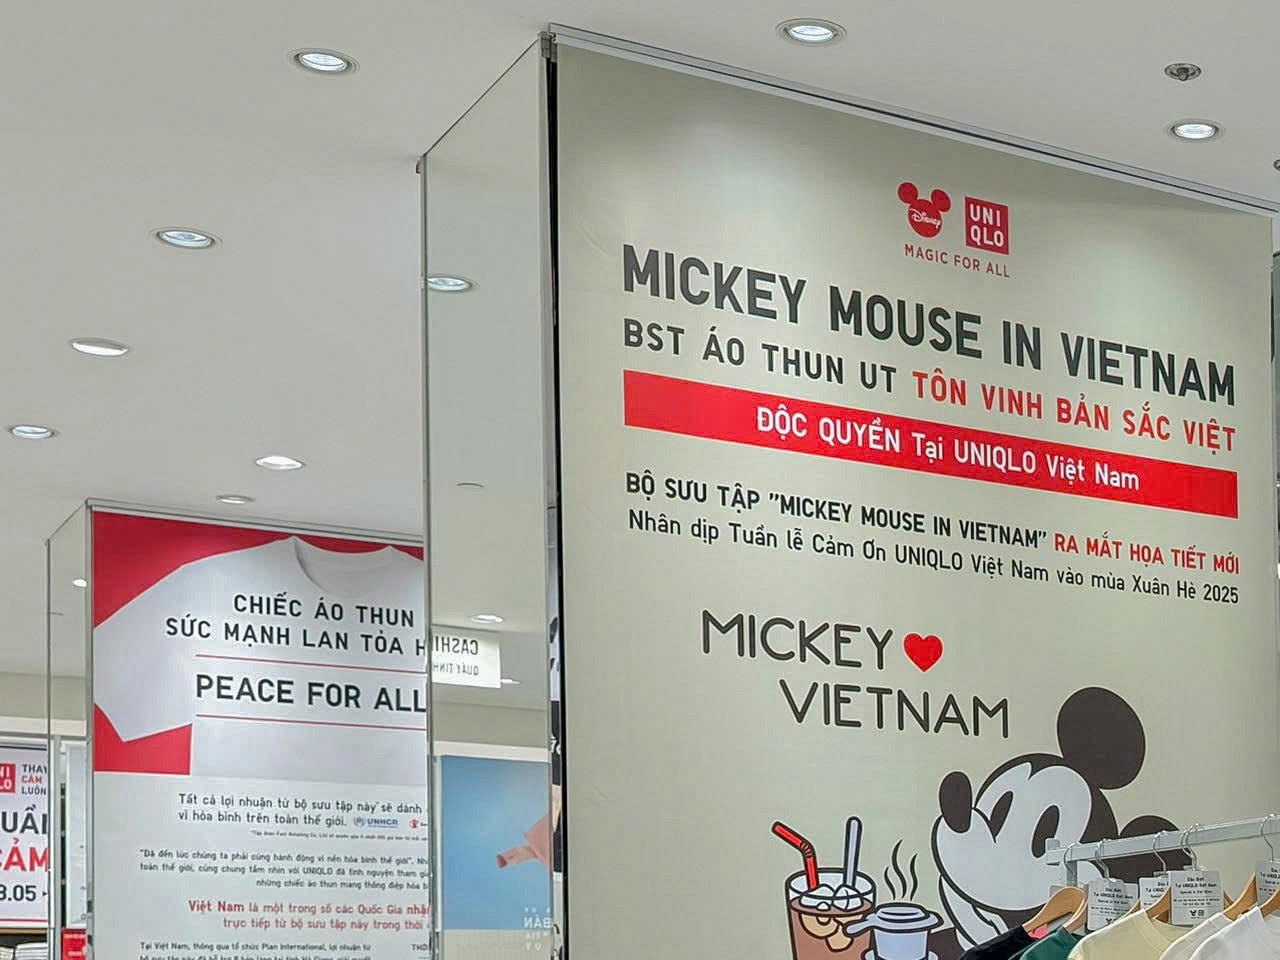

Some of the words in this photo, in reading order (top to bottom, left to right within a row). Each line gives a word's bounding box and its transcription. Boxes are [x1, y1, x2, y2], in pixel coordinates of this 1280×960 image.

[969, 203, 1001, 227] UNI
[970, 225, 1004, 247] QLO
[905, 243, 949, 265] MAGIC
[954, 254, 980, 272] FOR
[986, 261, 1010, 278] ALL
[623, 243, 807, 324] MICKEY
[829, 285, 982, 359] MOUSE
[1002, 320, 1041, 370] IN
[1060, 332, 1235, 406] VIETNAM
[624, 317, 685, 355] BST
[703, 326, 745, 366] ÁO
[762, 343, 844, 385] THUN
[860, 361, 897, 393] UT
[912, 367, 967, 407] TÔN
[981, 383, 1042, 420] VINH
[1057, 393, 1110, 431] BẢN
[1123, 401, 1171, 441] SẮC
[1183, 418, 1236, 456] VIỆT
[757, 403, 808, 440] ĐỘC
[819, 416, 901, 454] QUYỀN
[912, 432, 944, 464] Tại
[954, 439, 1037, 474] UNIQLO
[1046, 453, 1086, 486] Việt
[1095, 462, 1140, 490] Nam
[626, 470, 655, 500] BỘ
[664, 478, 707, 503] SƯU
[717, 482, 760, 513] TẬP
[861, 505, 925, 533] MOUSE
[933, 516, 951, 537] IN
[1054, 532, 1079, 554] RA
[1086, 531, 1122, 560] MẮT
[1130, 543, 1164, 568] HỌA
[1171, 545, 1206, 570] TIẾT
[1213, 553, 1240, 575] MỚI
[629, 508, 681, 535] Nhân
[690, 518, 719, 544] dịp
[728, 522, 777, 548] Tuần
[787, 527, 803, 551] lễ
[812, 534, 854, 557] Cảm
[863, 539, 886, 562] Ơn
[895, 544, 963, 571] UNIQLO
[971, 554, 1003, 580] Việt
[1011, 559, 1048, 582] Nam
[1056, 566, 1084, 586] vào
[1091, 570, 1125, 591] mùa
[1132, 575, 1169, 597] Xuân
[1177, 580, 1196, 600] Hè
[1203, 583, 1239, 604] 2025
[234, 592, 302, 618] CHIẾC
[314, 597, 344, 621] ÁO
[357, 605, 414, 627] THUN
[165, 615, 211, 639] SỨC
[224, 624, 290, 648] MẠNH
[303, 629, 348, 651] LAN
[360, 630, 404, 655] TỎA
[702, 609, 893, 670] MICKEY
[196, 674, 295, 705] PEACE
[308, 682, 361, 709] FOR
[374, 687, 426, 713] ALL
[779, 679, 1009, 739] VIETNAM
[188, 900, 212, 914] Việt
[217, 901, 245, 912] Nam
[288, 903, 316, 915] trong
[387, 905, 403, 915] Gia
[373, 919, 401, 932] trong
